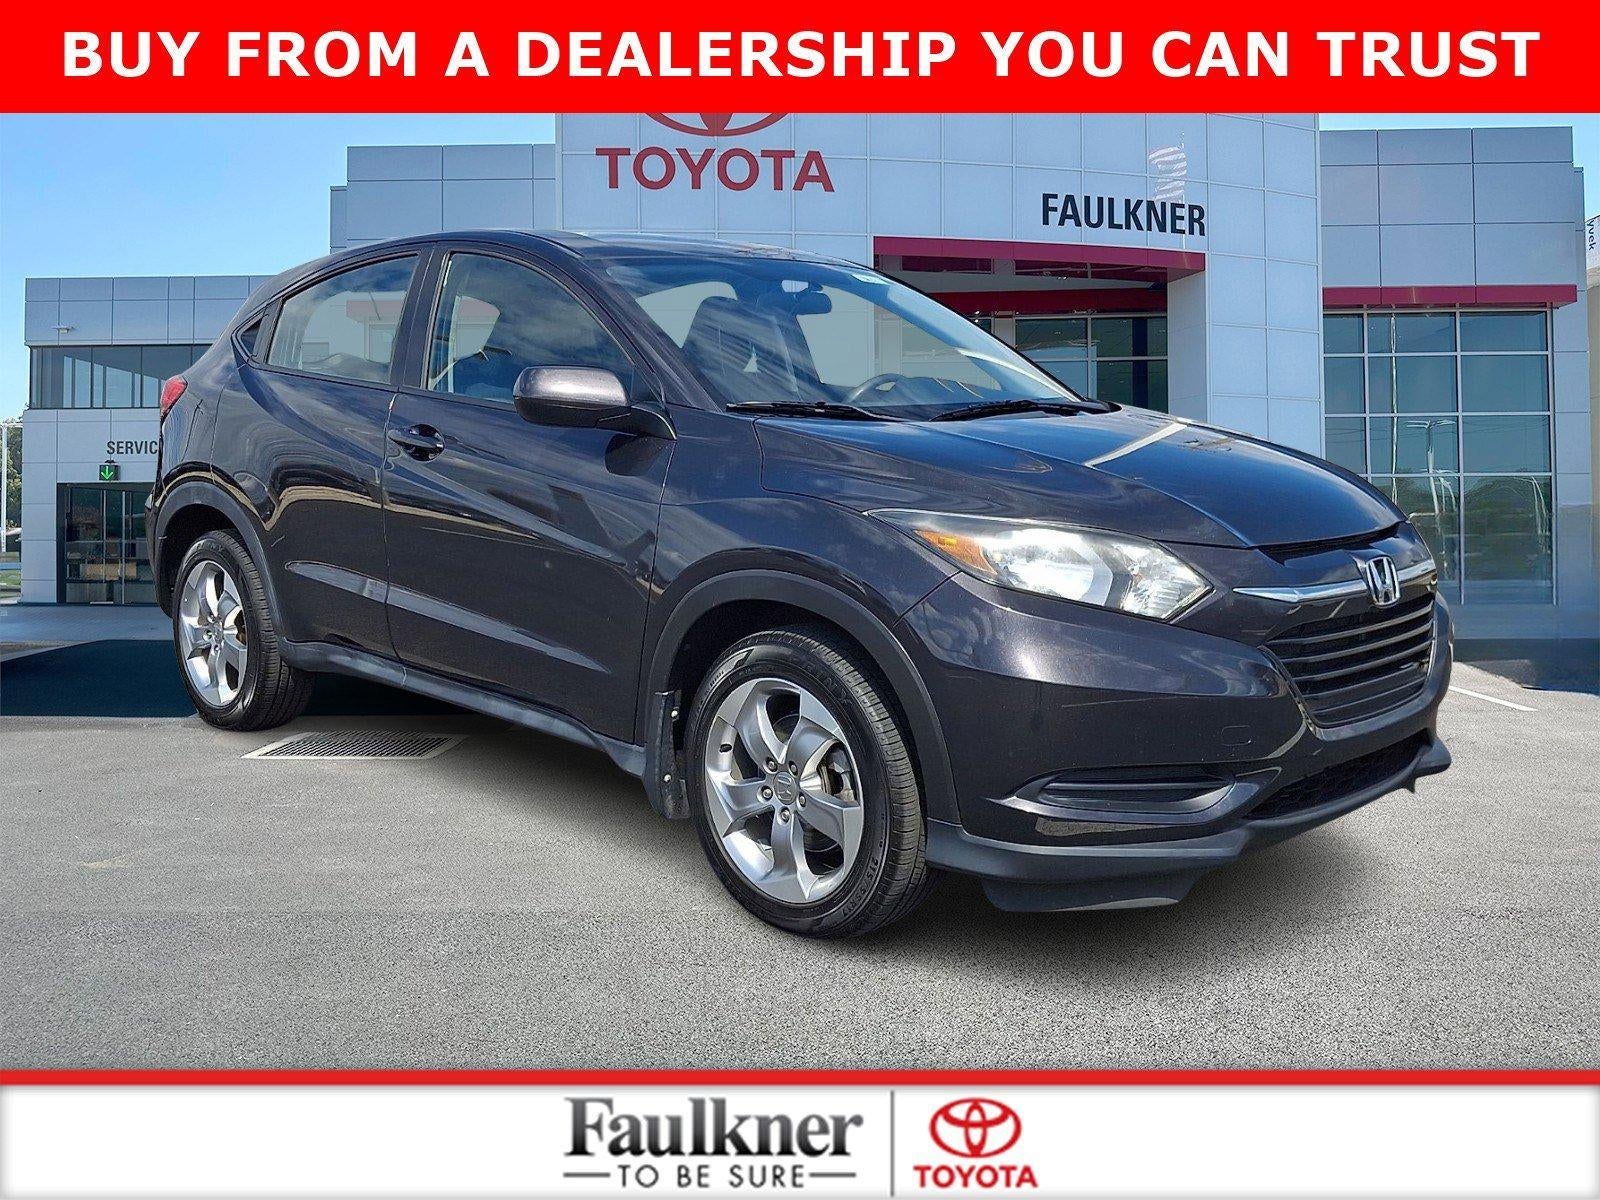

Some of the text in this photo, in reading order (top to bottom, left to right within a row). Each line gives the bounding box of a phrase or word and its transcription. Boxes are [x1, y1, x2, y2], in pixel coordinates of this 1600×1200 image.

[596, 147, 834, 192] TOYOTA
[1041, 193, 1206, 237] FAULKNER
[1587, 219, 1596, 250] yvek
[106, 440, 158, 455] SERVIC
